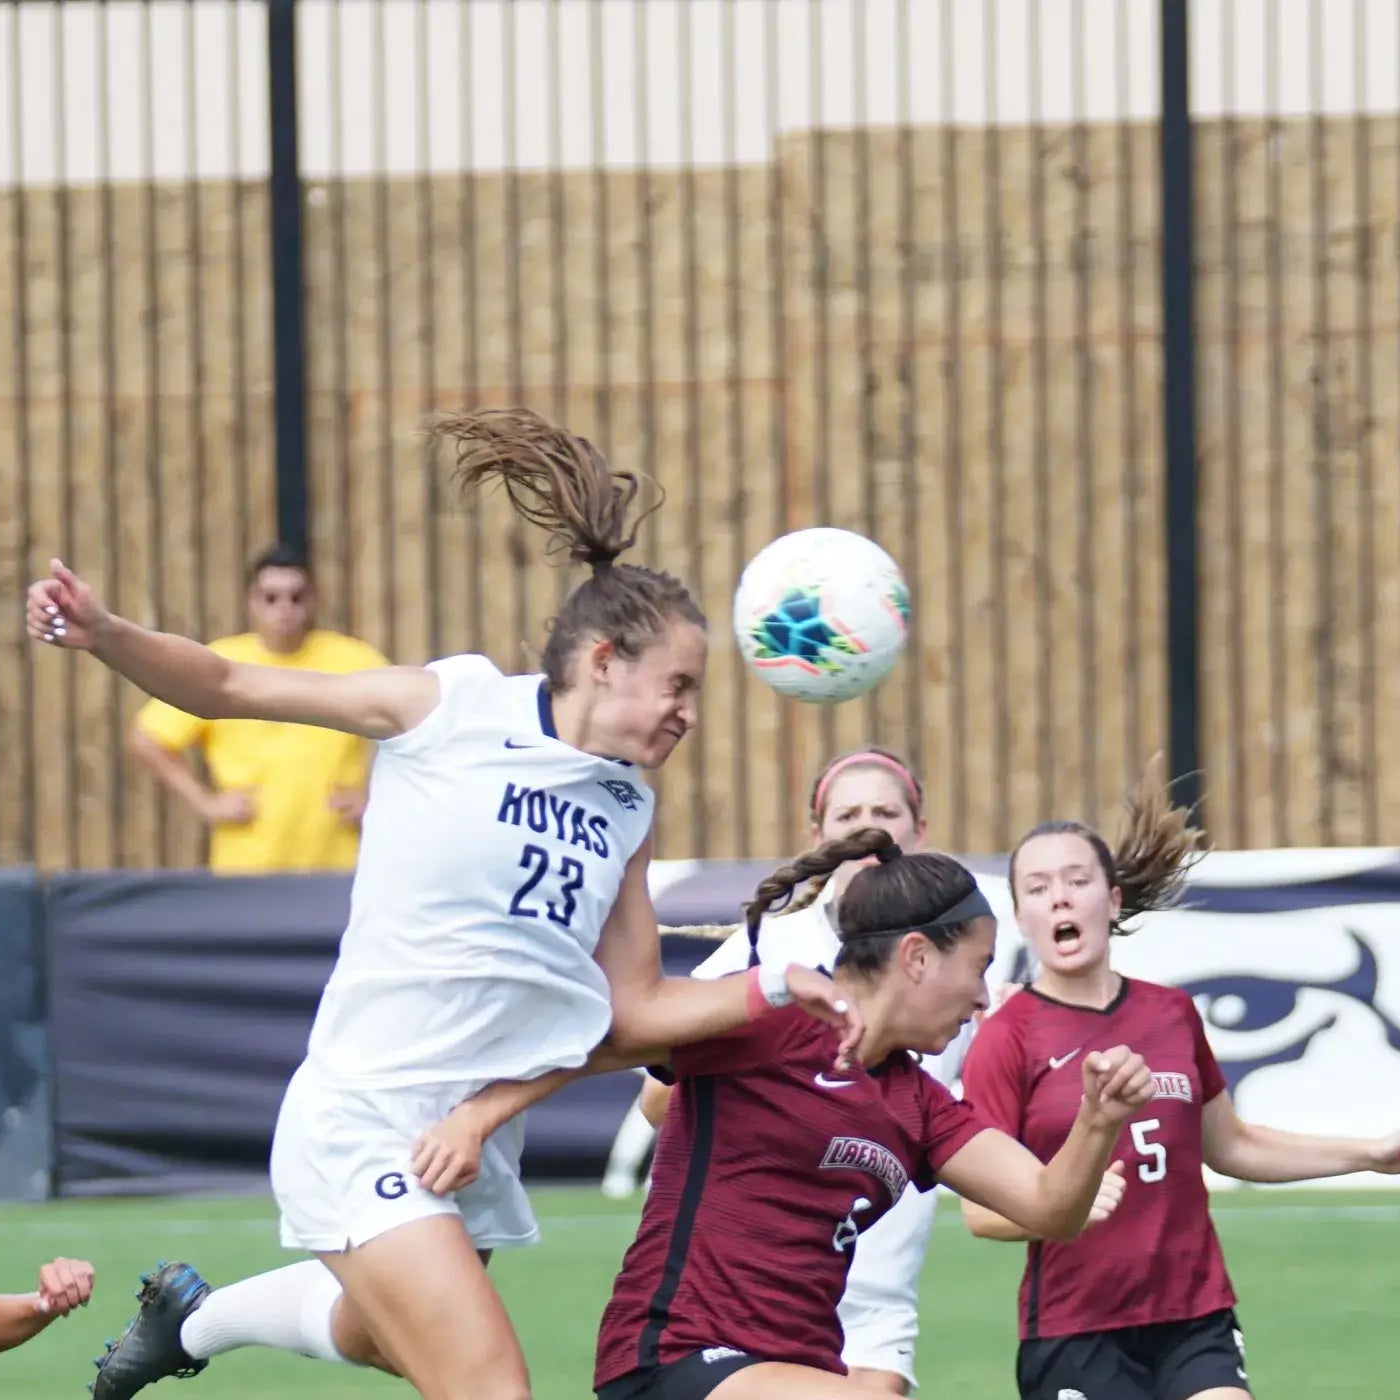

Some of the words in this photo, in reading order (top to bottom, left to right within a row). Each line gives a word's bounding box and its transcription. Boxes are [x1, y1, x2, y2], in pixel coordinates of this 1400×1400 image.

[497, 782, 609, 859] HOYAS
[509, 843, 584, 928] 23
[374, 1172, 408, 1199] G
[1130, 1118, 1167, 1183] 5
